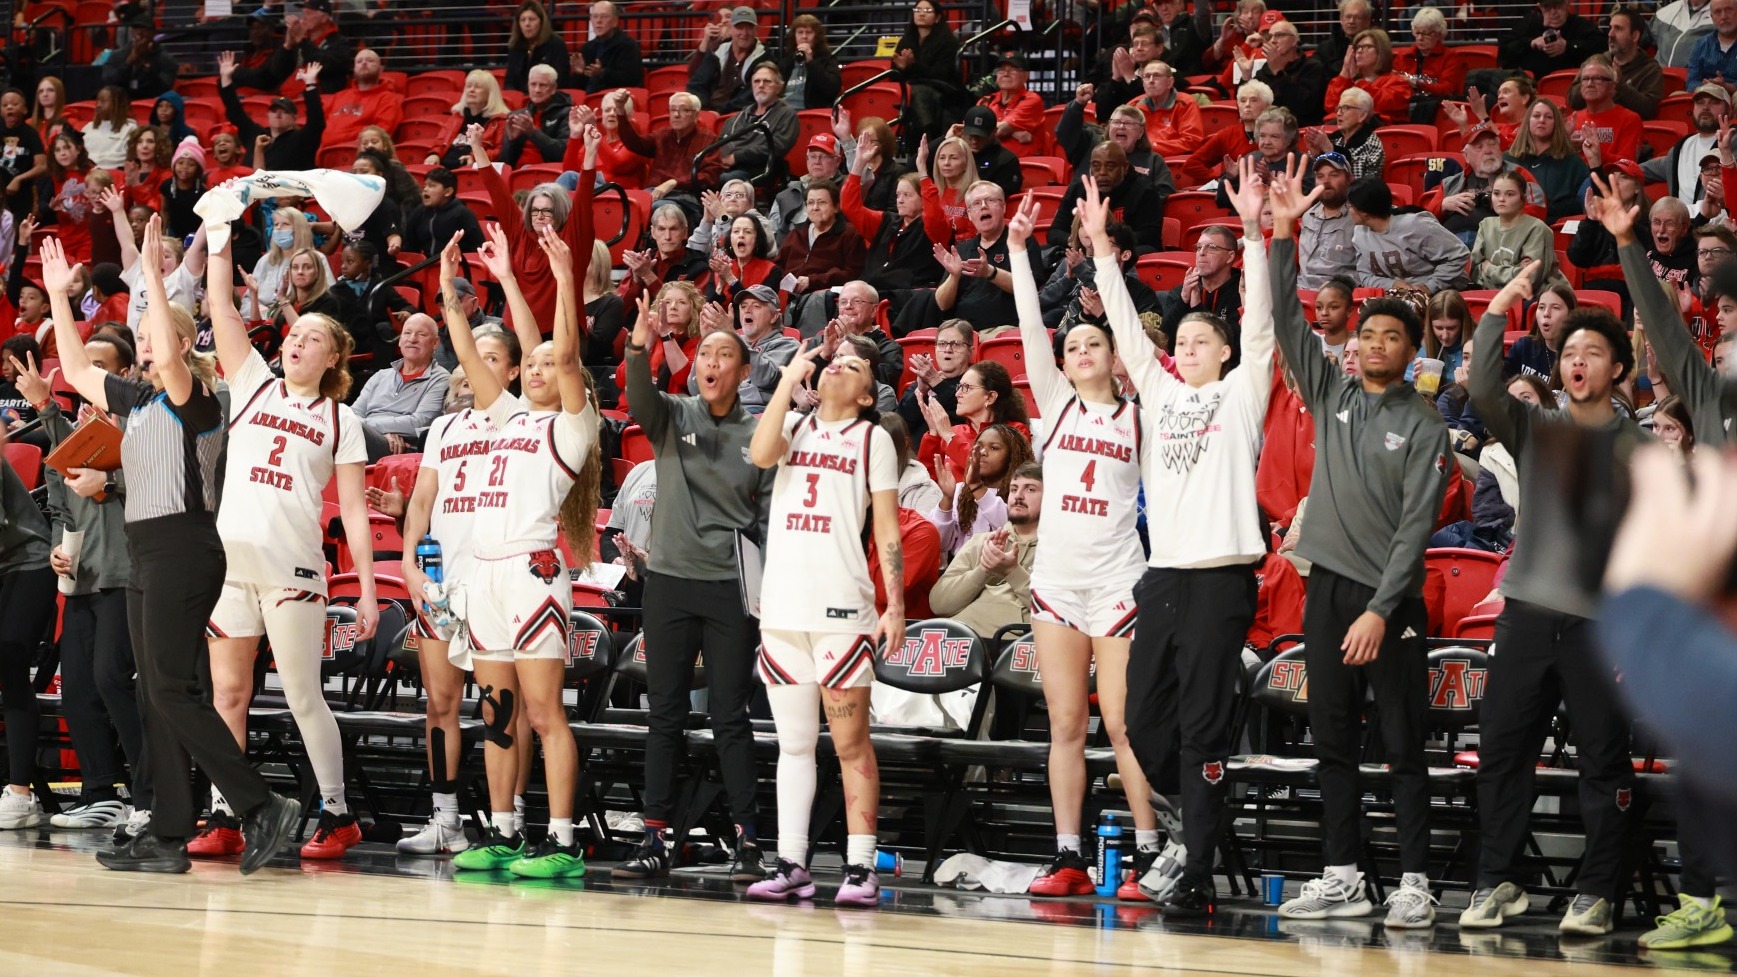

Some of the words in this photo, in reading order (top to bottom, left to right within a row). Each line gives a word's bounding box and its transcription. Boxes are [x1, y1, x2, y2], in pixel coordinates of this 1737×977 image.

[249, 411, 325, 446] ARKANSAS
[268, 435, 287, 467] 2
[440, 440, 490, 463] ARKANSA
[1057, 433, 1132, 463] ARKANSAS
[249, 466, 294, 492] STATE
[453, 460, 467, 492] 5
[488, 455, 509, 486] 21
[1080, 459, 1096, 492] 4
[803, 473, 820, 508] 3
[1061, 494, 1109, 517] STATE
[786, 513, 832, 533] STATE
